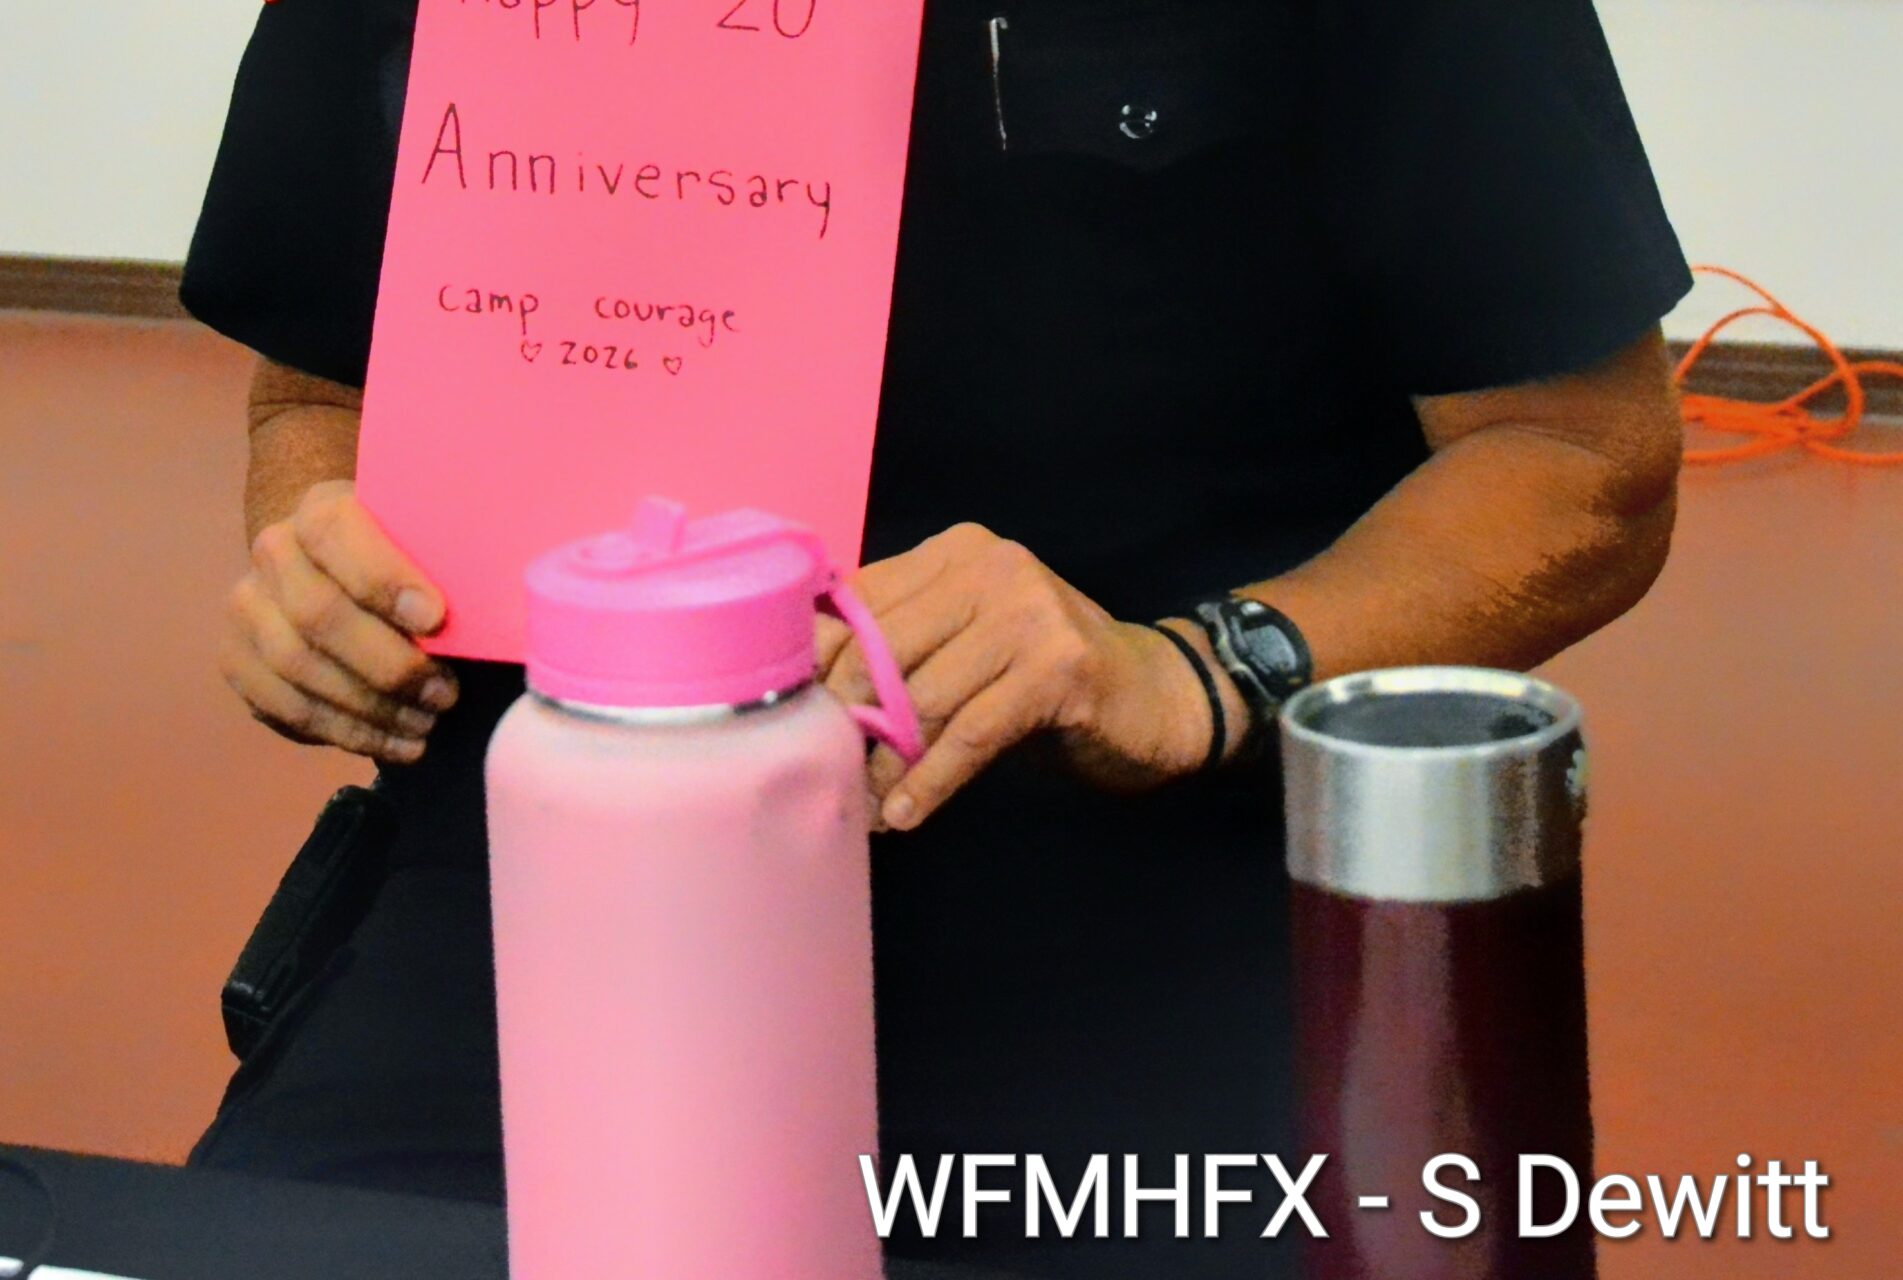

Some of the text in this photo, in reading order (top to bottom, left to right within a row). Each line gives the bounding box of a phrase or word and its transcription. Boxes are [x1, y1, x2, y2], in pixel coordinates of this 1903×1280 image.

[422, 102, 831, 240] Anniversary
[595, 296, 741, 347] courage
[560, 340, 639, 371] 2026
